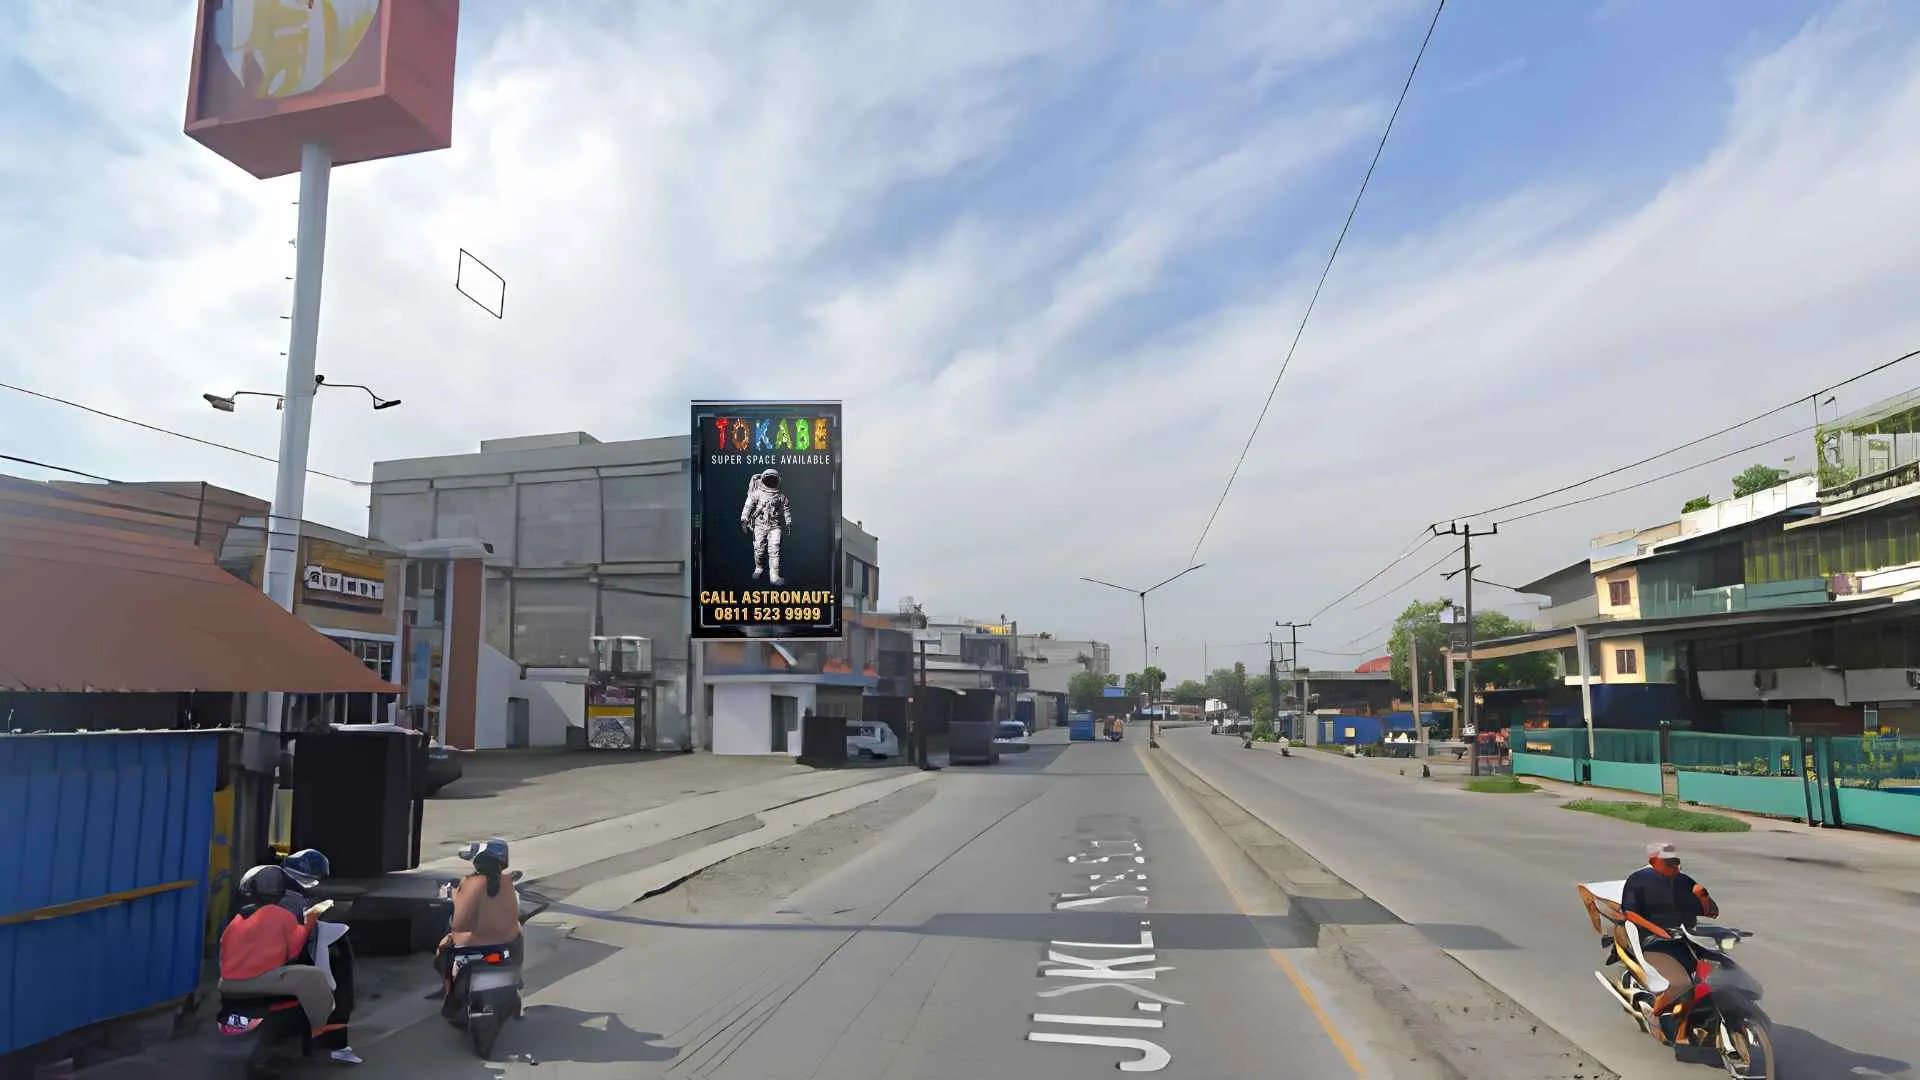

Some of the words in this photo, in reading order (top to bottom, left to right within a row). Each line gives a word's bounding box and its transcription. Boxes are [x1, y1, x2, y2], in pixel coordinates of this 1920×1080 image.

[715, 418, 829, 451] TOKABE
[711, 455, 742, 465] SUPER
[746, 455, 776, 465] SPACE
[780, 455, 831, 465] AVAILABLE
[701, 591, 736, 604] CALL
[741, 591, 835, 604] ASTRONAUT:
[714, 607, 748, 621] 0811
[753, 607, 781, 621] 523
[785, 607, 821, 621] 9999
